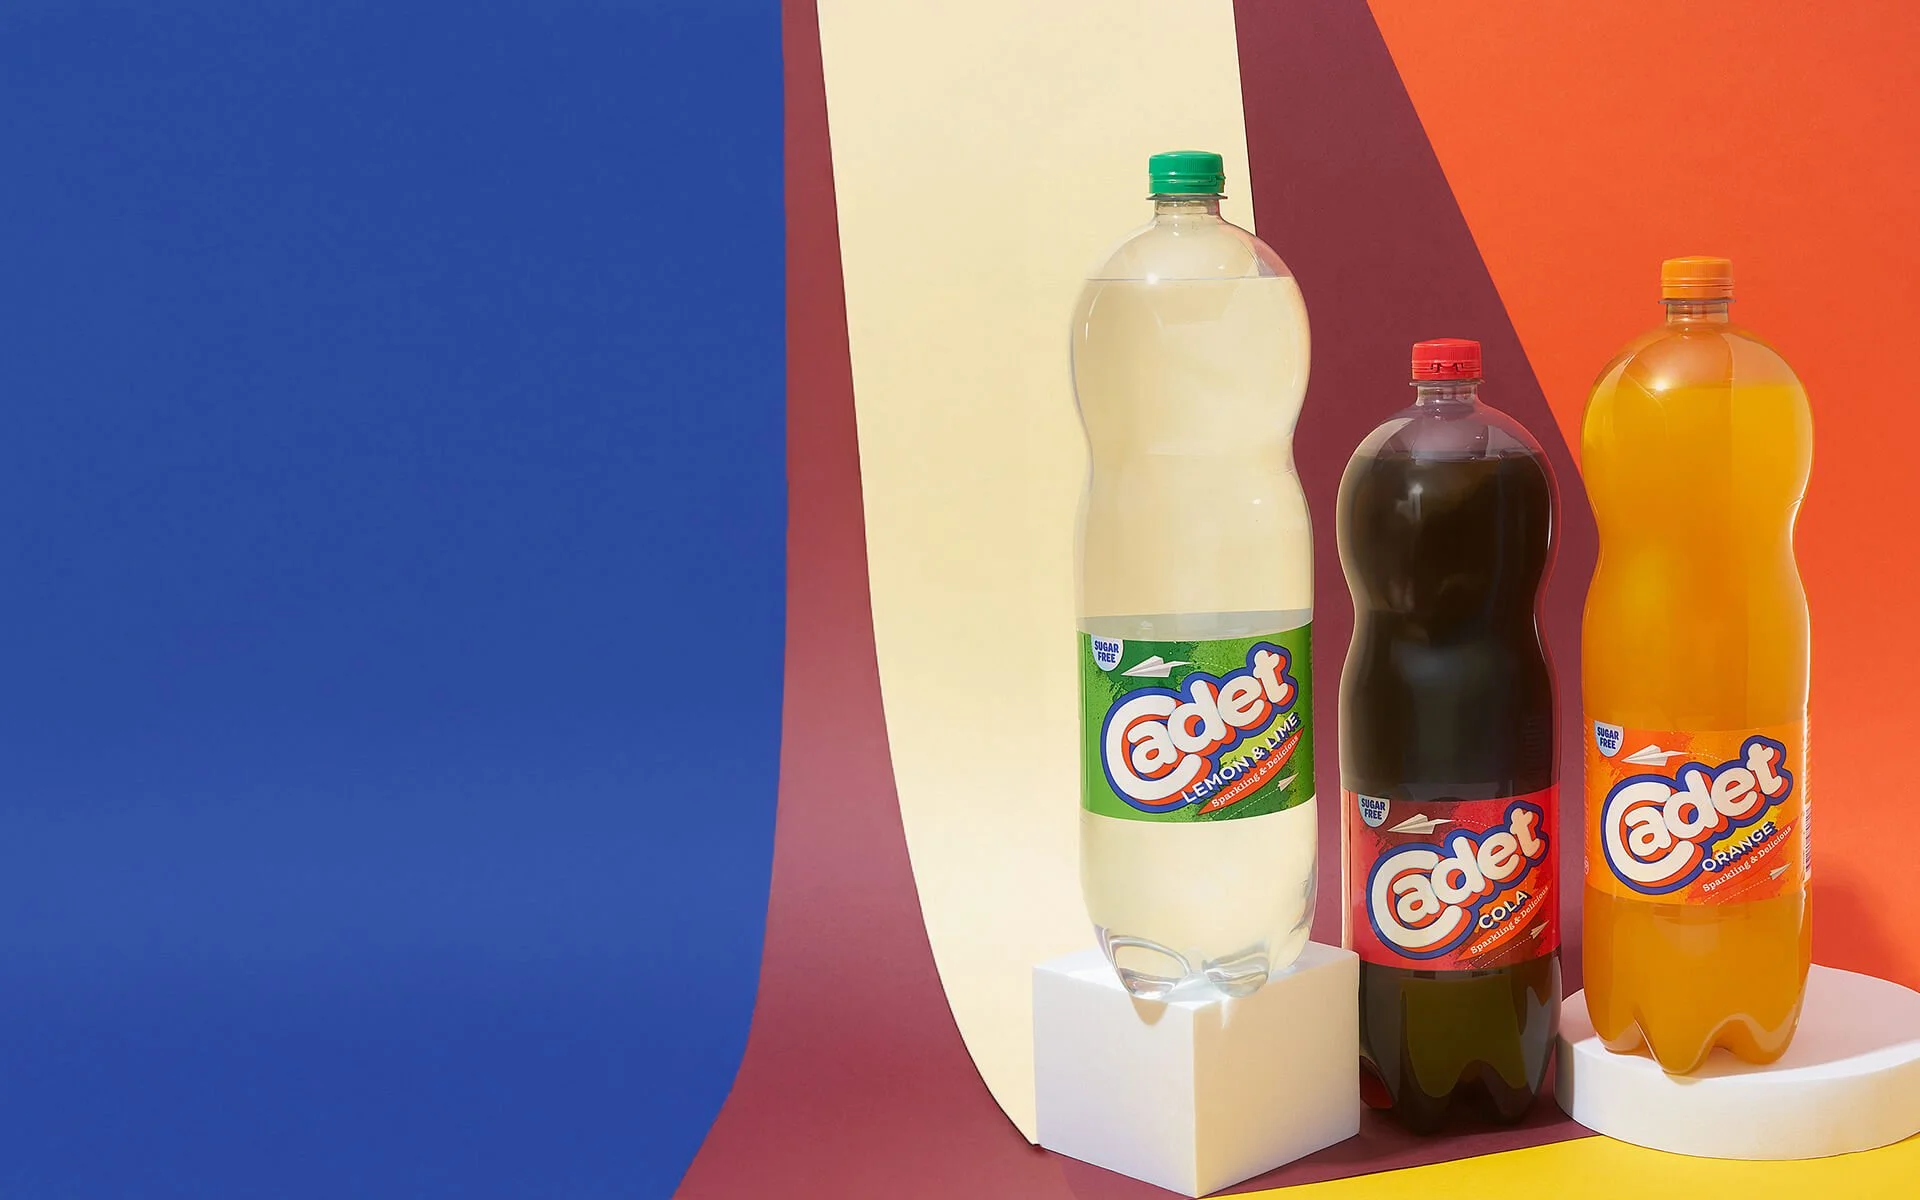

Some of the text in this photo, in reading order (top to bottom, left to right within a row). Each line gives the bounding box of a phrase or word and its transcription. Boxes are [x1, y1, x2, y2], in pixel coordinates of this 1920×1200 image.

[1094, 640, 1119, 653] SUGAR
[1097, 653, 1116, 663] FREE
[1104, 649, 1294, 805] Cadet
[1597, 726, 1619, 741] SUGAR
[1600, 738, 1616, 749] FREE
[1182, 714, 1299, 804] LEMON & LIME
[1211, 736, 1299, 808] Sparkling & Delicious
[1361, 798, 1386, 811] SUGAR
[1364, 809, 1383, 820] FREE
[1605, 742, 1789, 889] Cadet
[1702, 821, 1776, 872] ORANGE
[1702, 825, 1792, 892] Sparkling & Delicious
[1371, 807, 1545, 953] Cadet
[1470, 886, 1549, 955] Sparkling & Delicious
[1478, 890, 1530, 930] COLA
